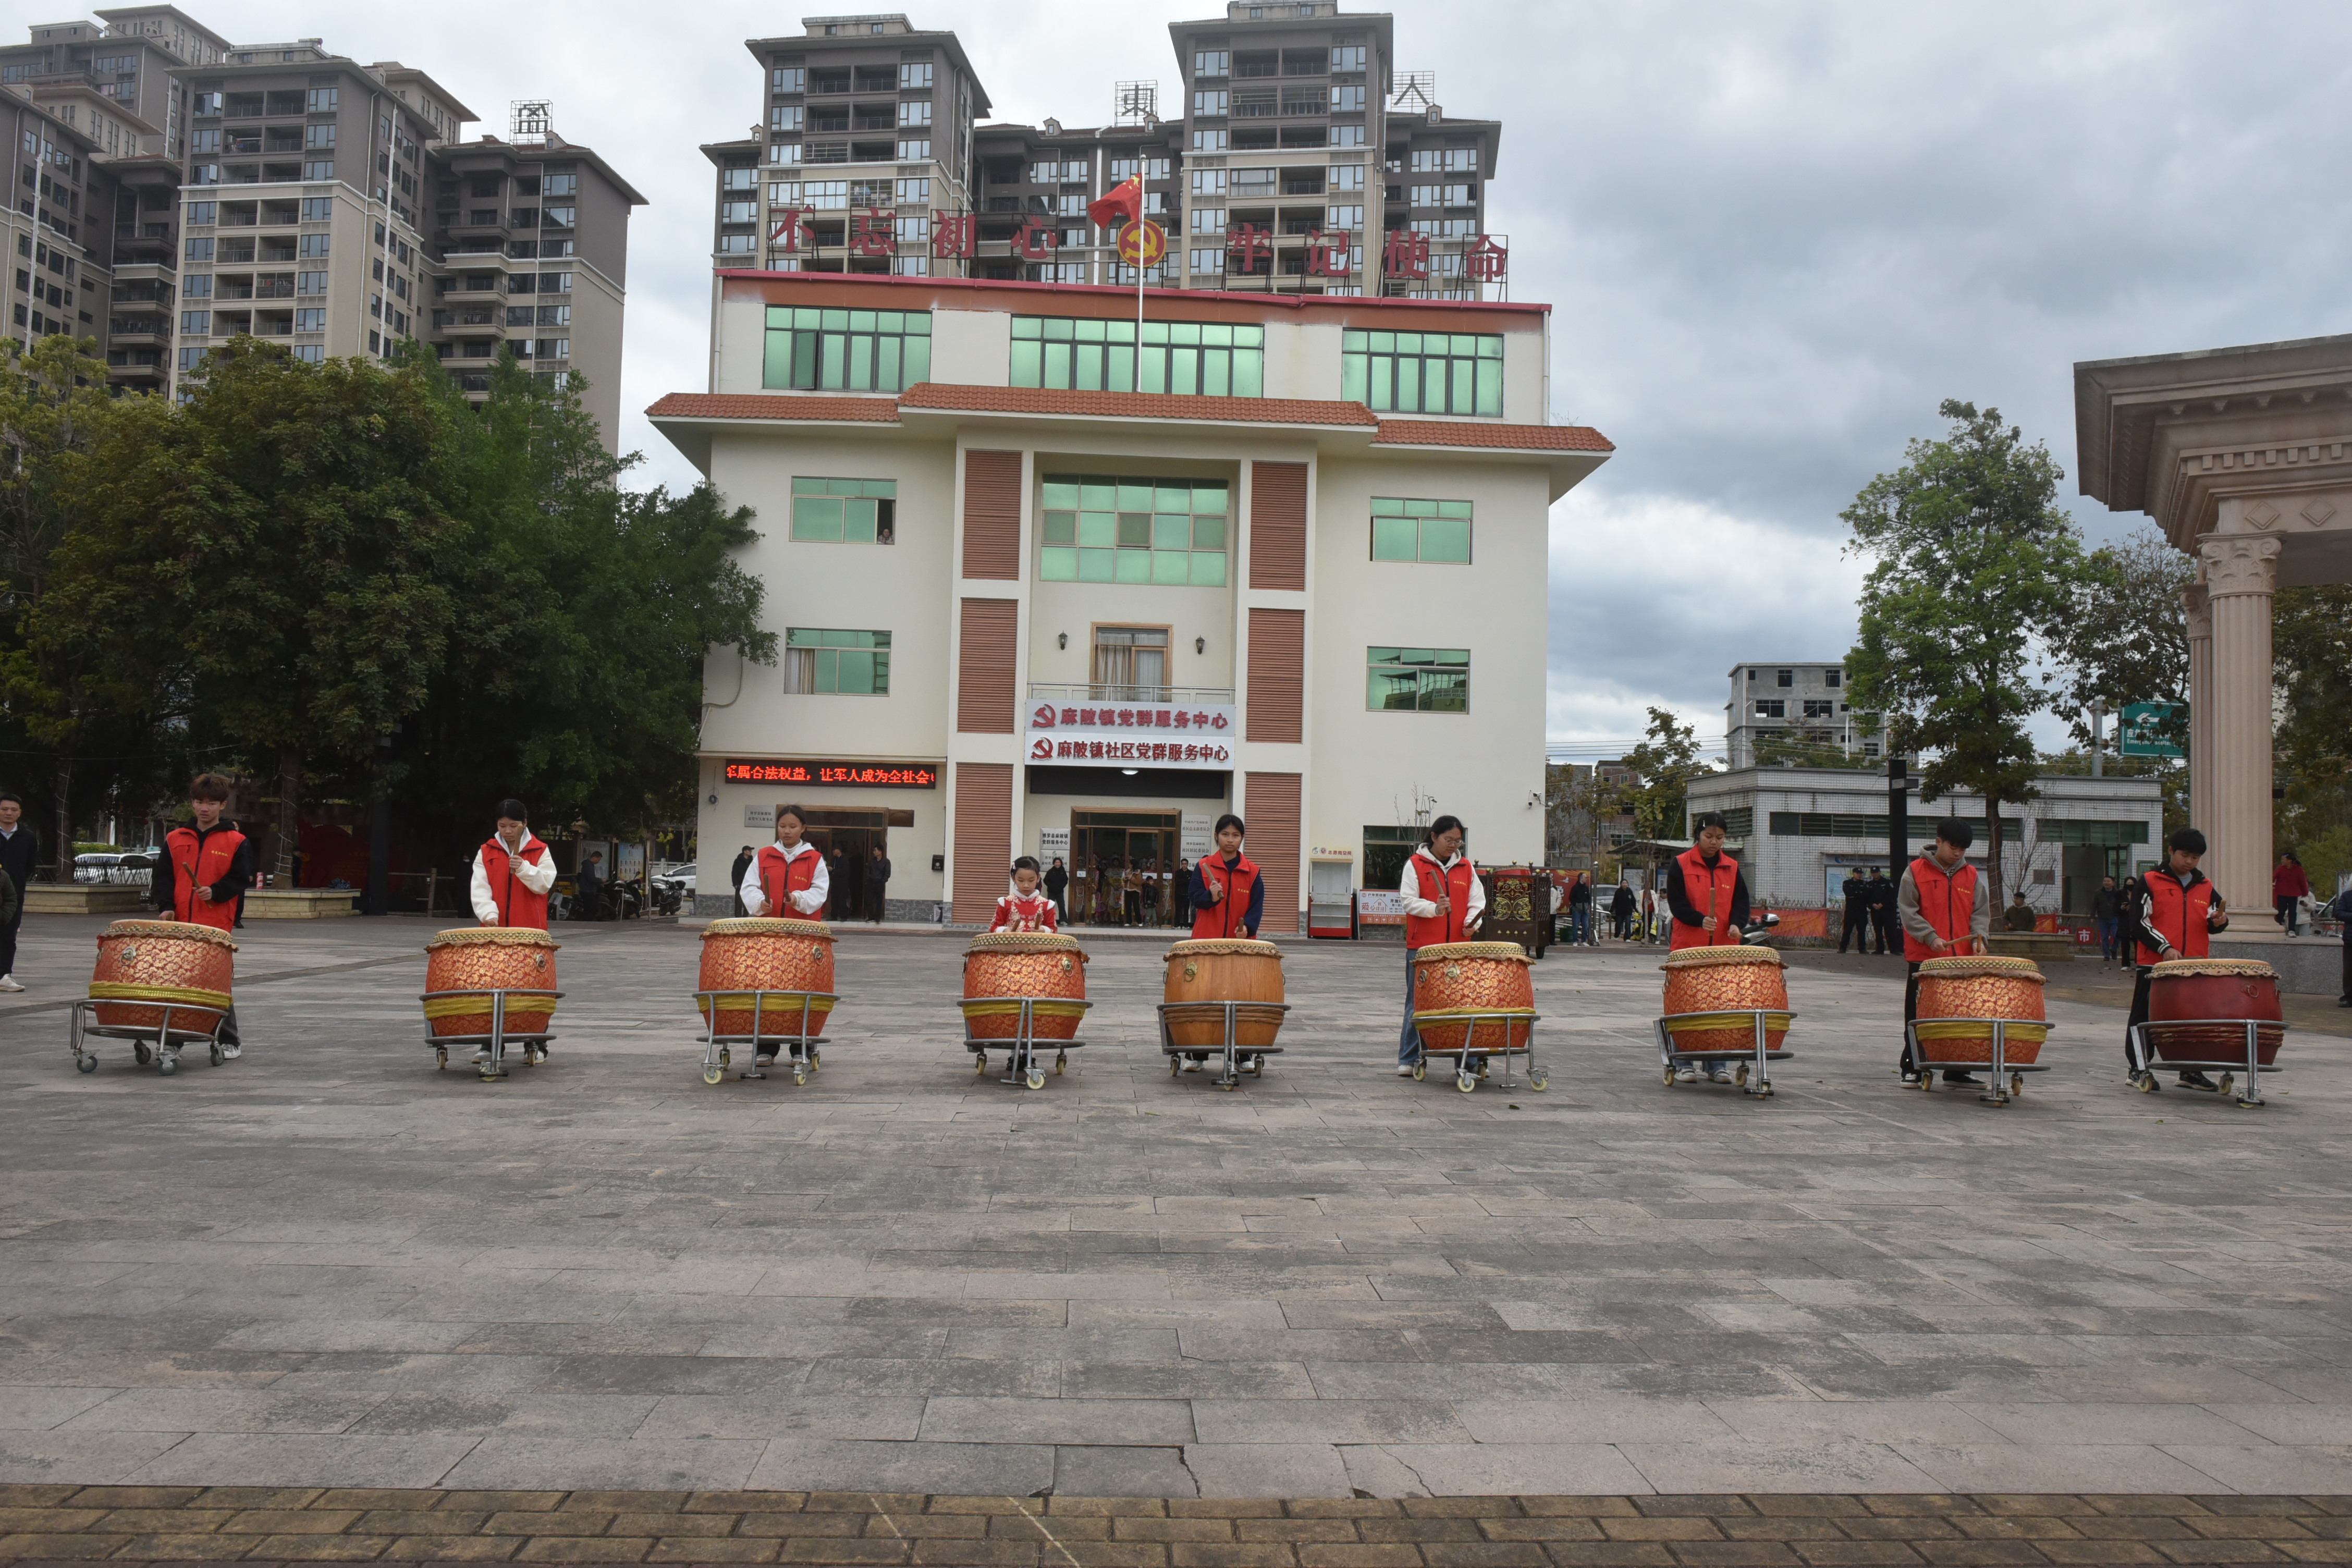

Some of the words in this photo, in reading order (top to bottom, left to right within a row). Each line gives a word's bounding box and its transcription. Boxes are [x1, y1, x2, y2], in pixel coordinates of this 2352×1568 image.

[769, 205, 1057, 259] 不忘初心
[1227, 223, 1509, 282] 牢记使命
[1060, 708, 1228, 729] 麻陂镇党群服务中心
[1057, 740, 1229, 762] 麻陂镇社区党群服务中心
